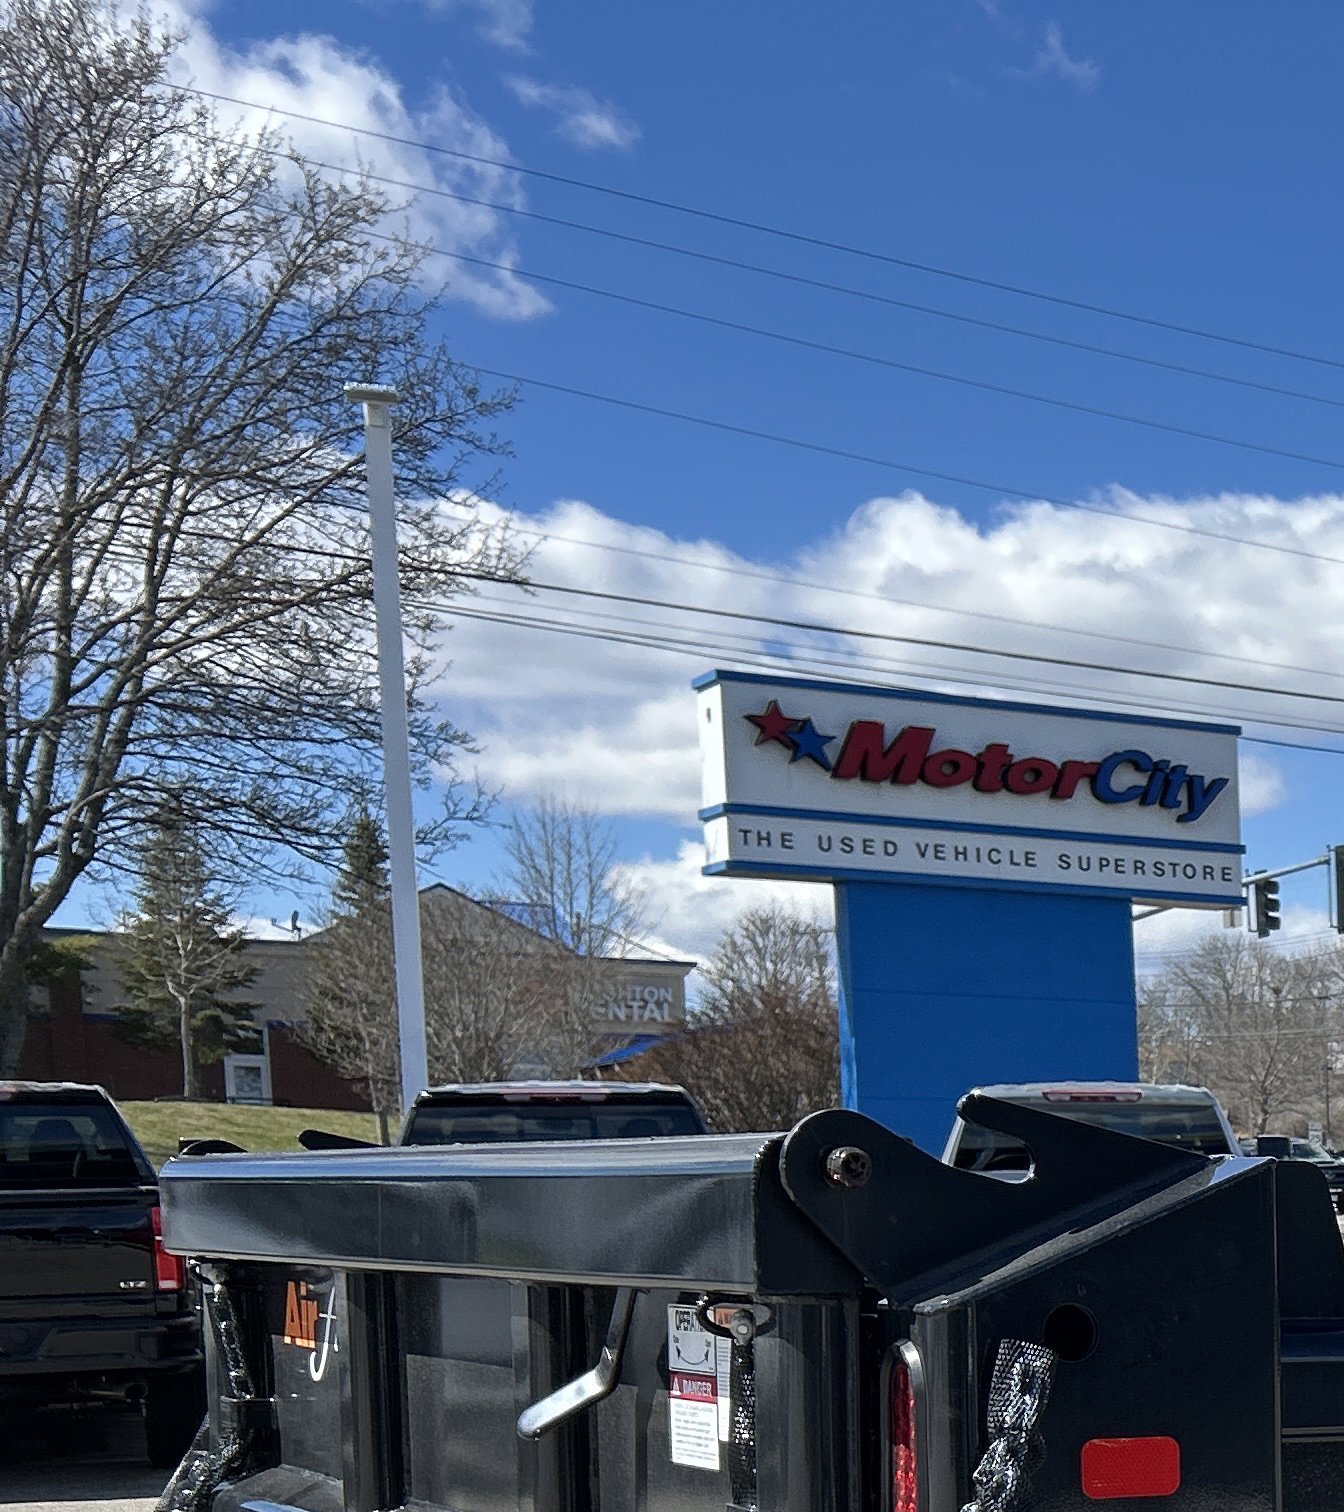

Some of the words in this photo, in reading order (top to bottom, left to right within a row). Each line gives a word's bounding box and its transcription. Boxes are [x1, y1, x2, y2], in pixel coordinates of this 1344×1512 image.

[831, 720, 1229, 823] MotorCity
[738, 828, 794, 850] THE
[817, 834, 898, 857] USED
[916, 841, 1037, 868] VEHICLE
[1058, 853, 1233, 882] SUPERSTORE
